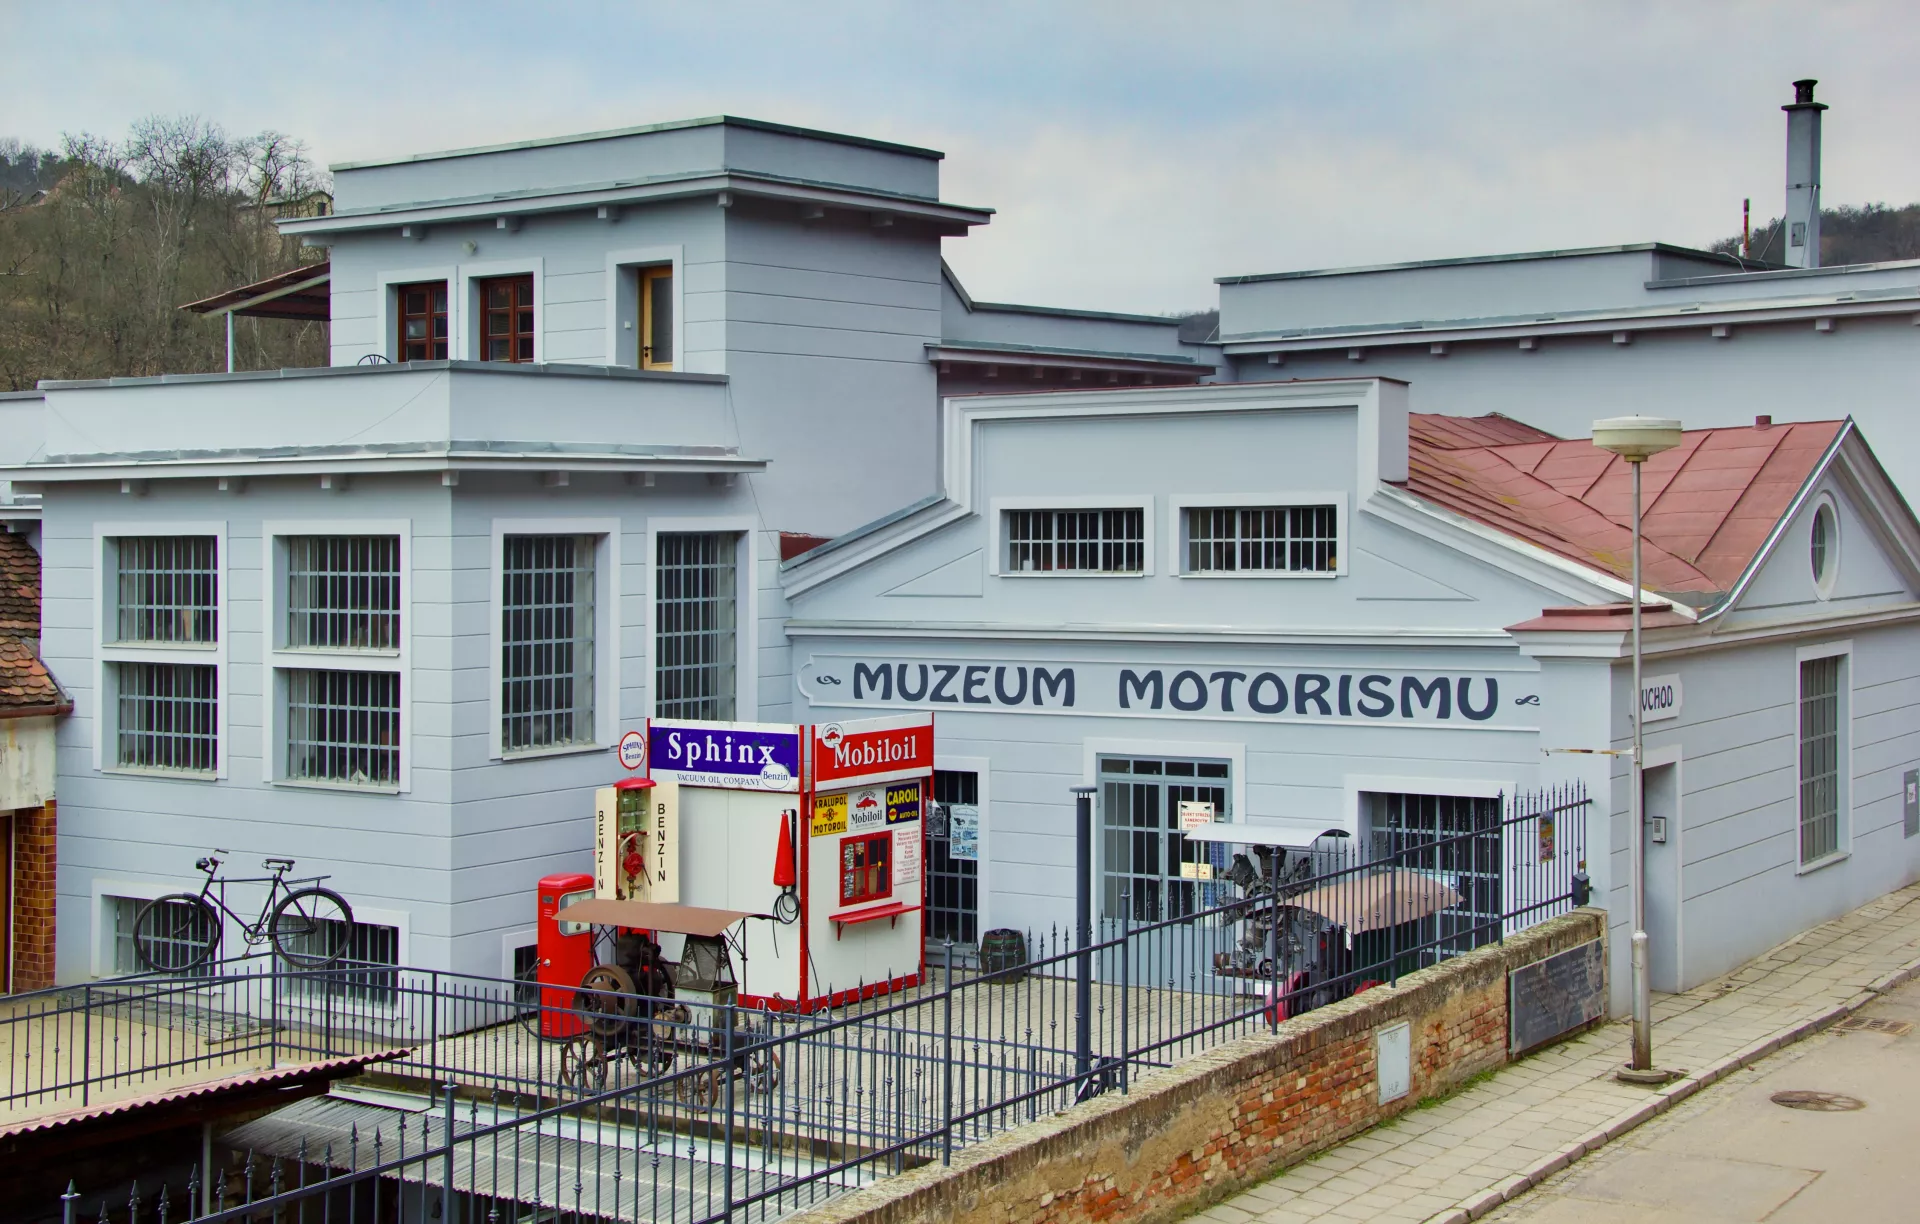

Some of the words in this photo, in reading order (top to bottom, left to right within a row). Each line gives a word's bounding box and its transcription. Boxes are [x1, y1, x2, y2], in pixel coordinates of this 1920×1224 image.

[853, 662, 1076, 707] MUZEUM
[1118, 669, 1499, 721] MOTORISMU
[1641, 684, 1673, 712] VCHOD
[668, 731, 776, 769] Sphinx
[833, 734, 917, 769] Mobiloil
[677, 773, 706, 784] VACUUM
[708, 775, 721, 784] OIL
[723, 776, 761, 786] COMPANY
[763, 770, 788, 781] Benzin
[814, 795, 847, 809] KRALUPOL
[886, 787, 919, 806] CAROIL
[813, 820, 847, 834] MOTOROIL
[851, 809, 883, 825] Mobiloil
[597, 810, 605, 890] BENZIN
[657, 803, 666, 882] BENZIN
